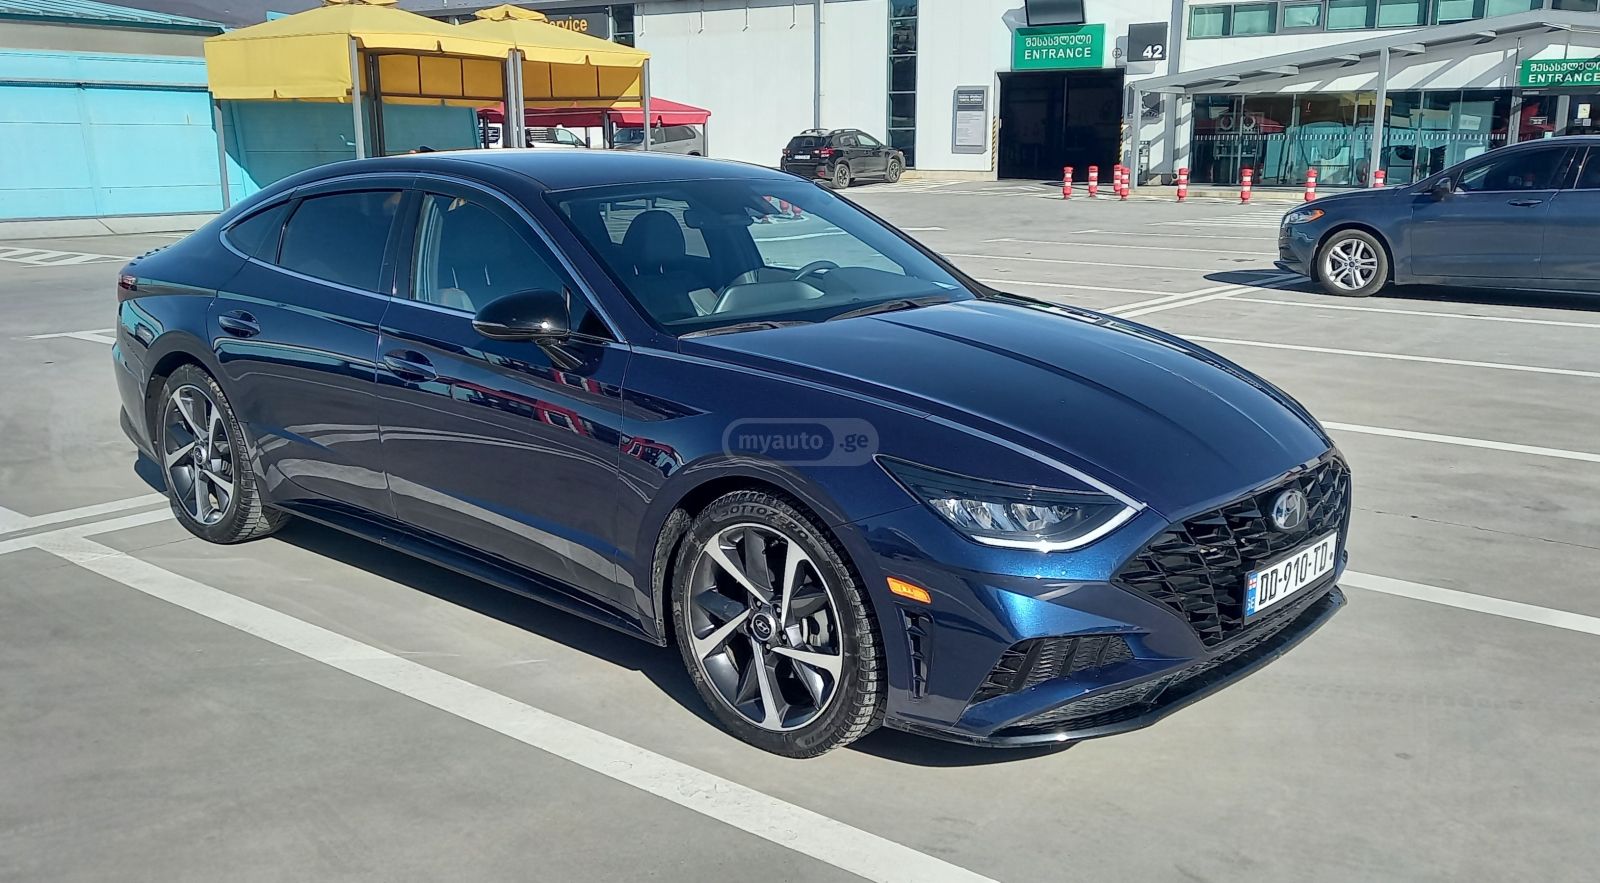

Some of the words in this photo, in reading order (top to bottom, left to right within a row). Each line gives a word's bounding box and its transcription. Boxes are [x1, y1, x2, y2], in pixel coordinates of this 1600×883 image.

[545, 15, 588, 32] ervice
[1025, 34, 1092, 47] შესასვლელი
[1024, 47, 1092, 60] ENTRANCE
[1142, 44, 1164, 59] 42
[1528, 72, 1600, 83] ENTRANCE
[1258, 541, 1328, 606] DD-910-TD
